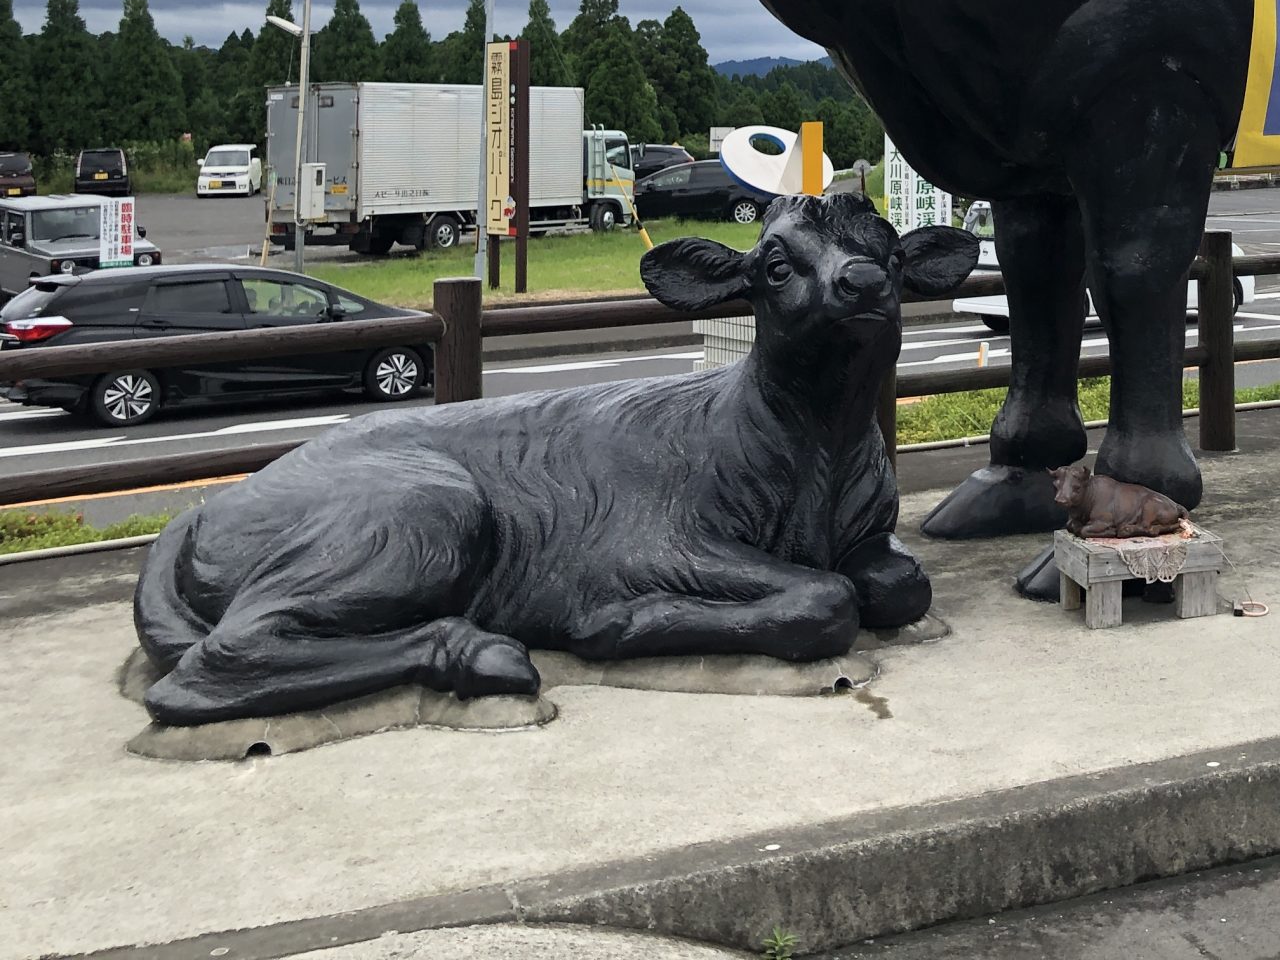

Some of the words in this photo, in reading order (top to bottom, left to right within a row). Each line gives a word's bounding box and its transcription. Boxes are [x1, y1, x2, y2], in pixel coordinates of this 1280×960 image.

[491, 52, 502, 221] 霧島ジオパーク
[890, 148, 902, 233] 大川原峡渓
[915, 172, 936, 227] 原峡渓
[120, 202, 132, 256] 臨時駐車場
